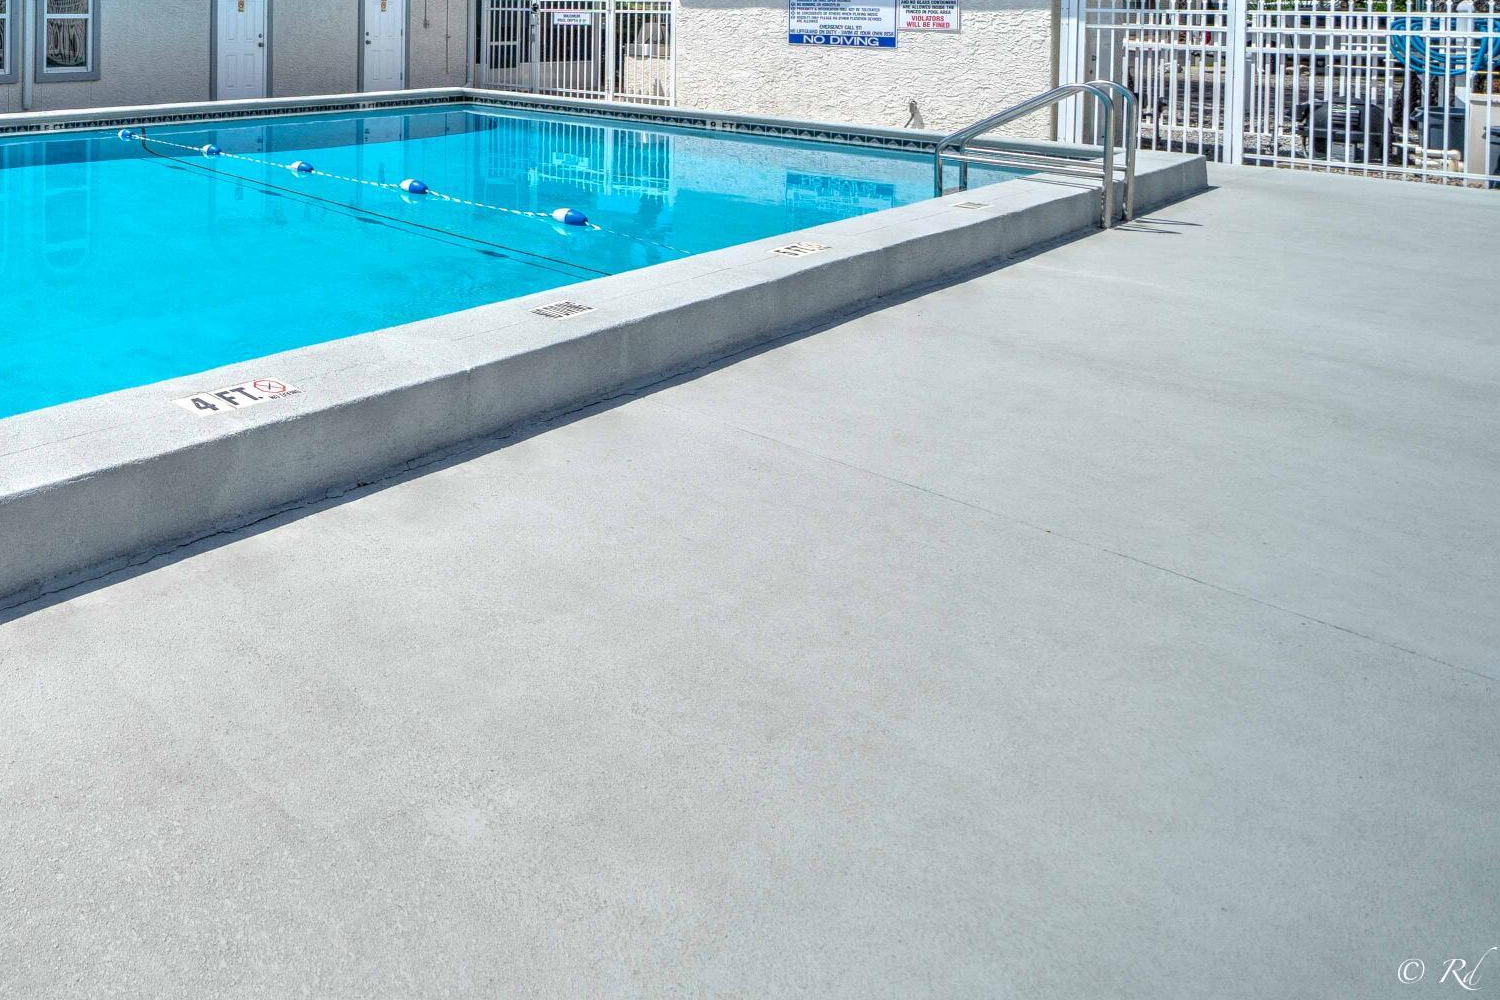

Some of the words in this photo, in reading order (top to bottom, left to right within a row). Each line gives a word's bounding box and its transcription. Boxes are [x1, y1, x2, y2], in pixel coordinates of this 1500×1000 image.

[803, 35, 825, 44] NO
[830, 35, 879, 46] DIVING
[191, 397, 219, 411] 4
